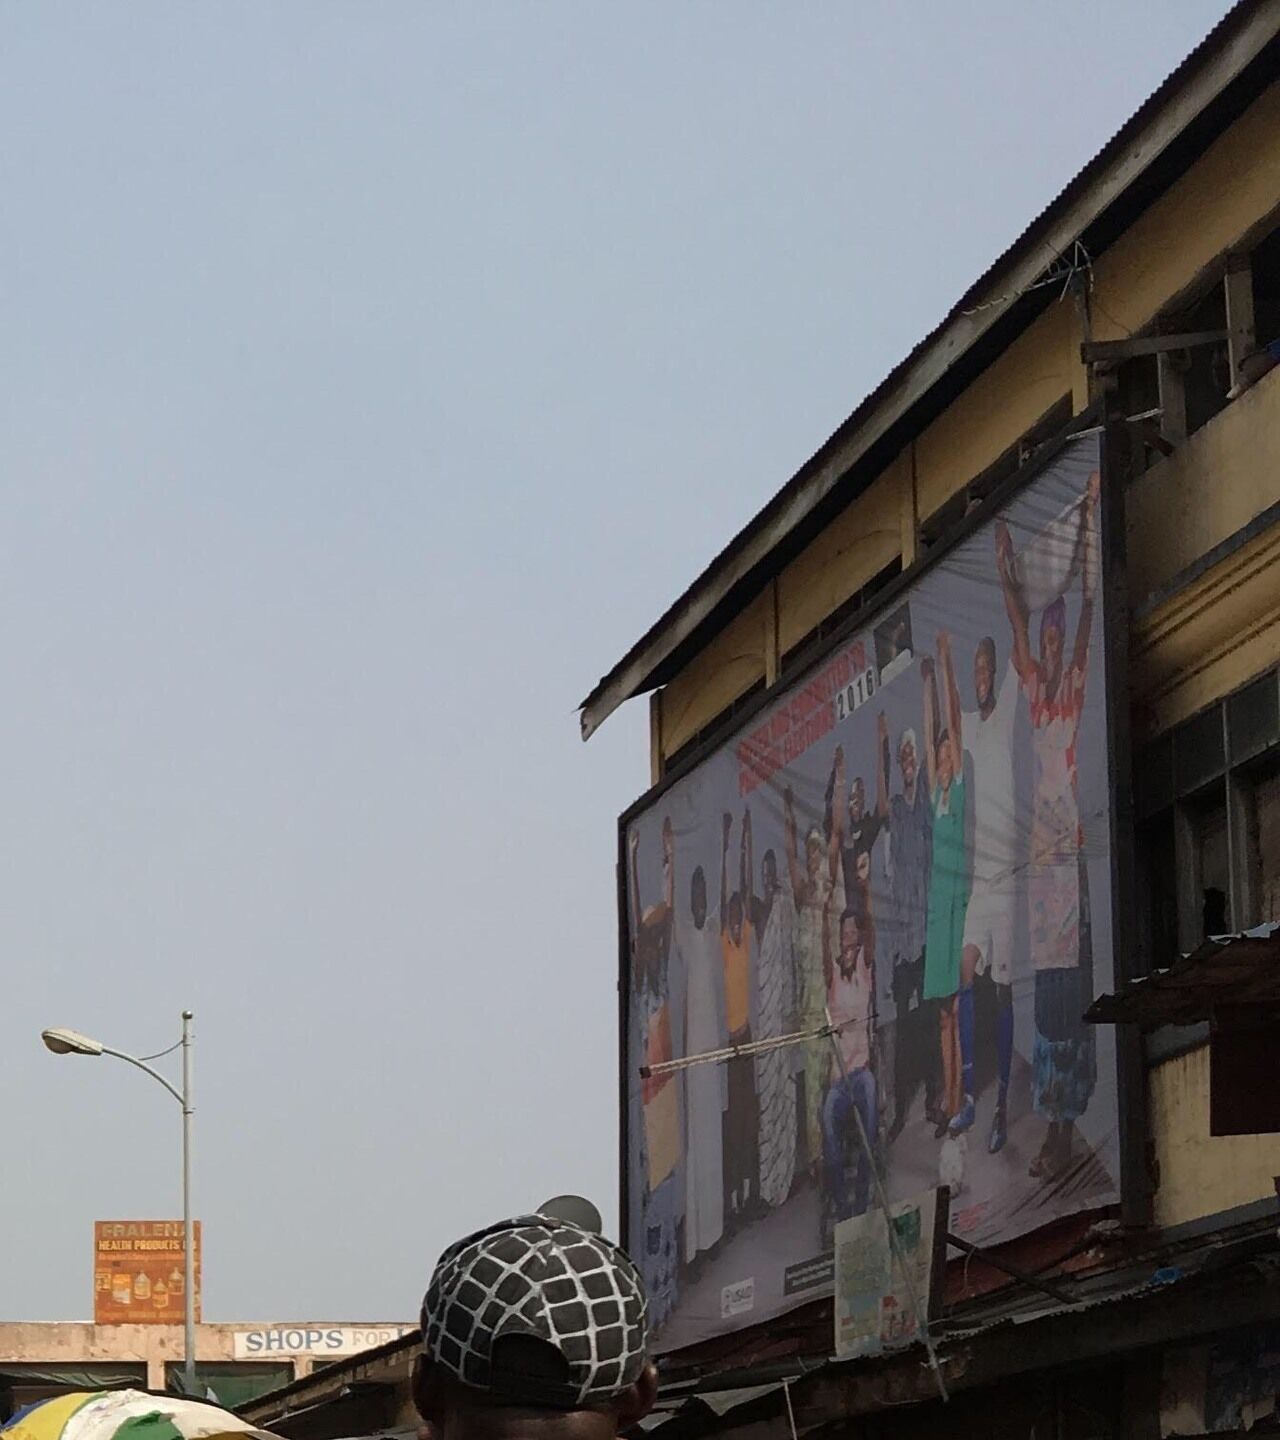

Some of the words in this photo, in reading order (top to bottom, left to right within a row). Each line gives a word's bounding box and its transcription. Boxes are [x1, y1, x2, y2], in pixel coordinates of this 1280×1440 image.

[837, 670, 874, 721] 2016
[102, 1223, 185, 1237] FRALEN
[98, 1240, 133, 1251] HEALTH
[134, 1240, 180, 1250] PRODUCTS
[246, 1329, 344, 1352] SHOPS
[352, 1331, 391, 1347] FOR
